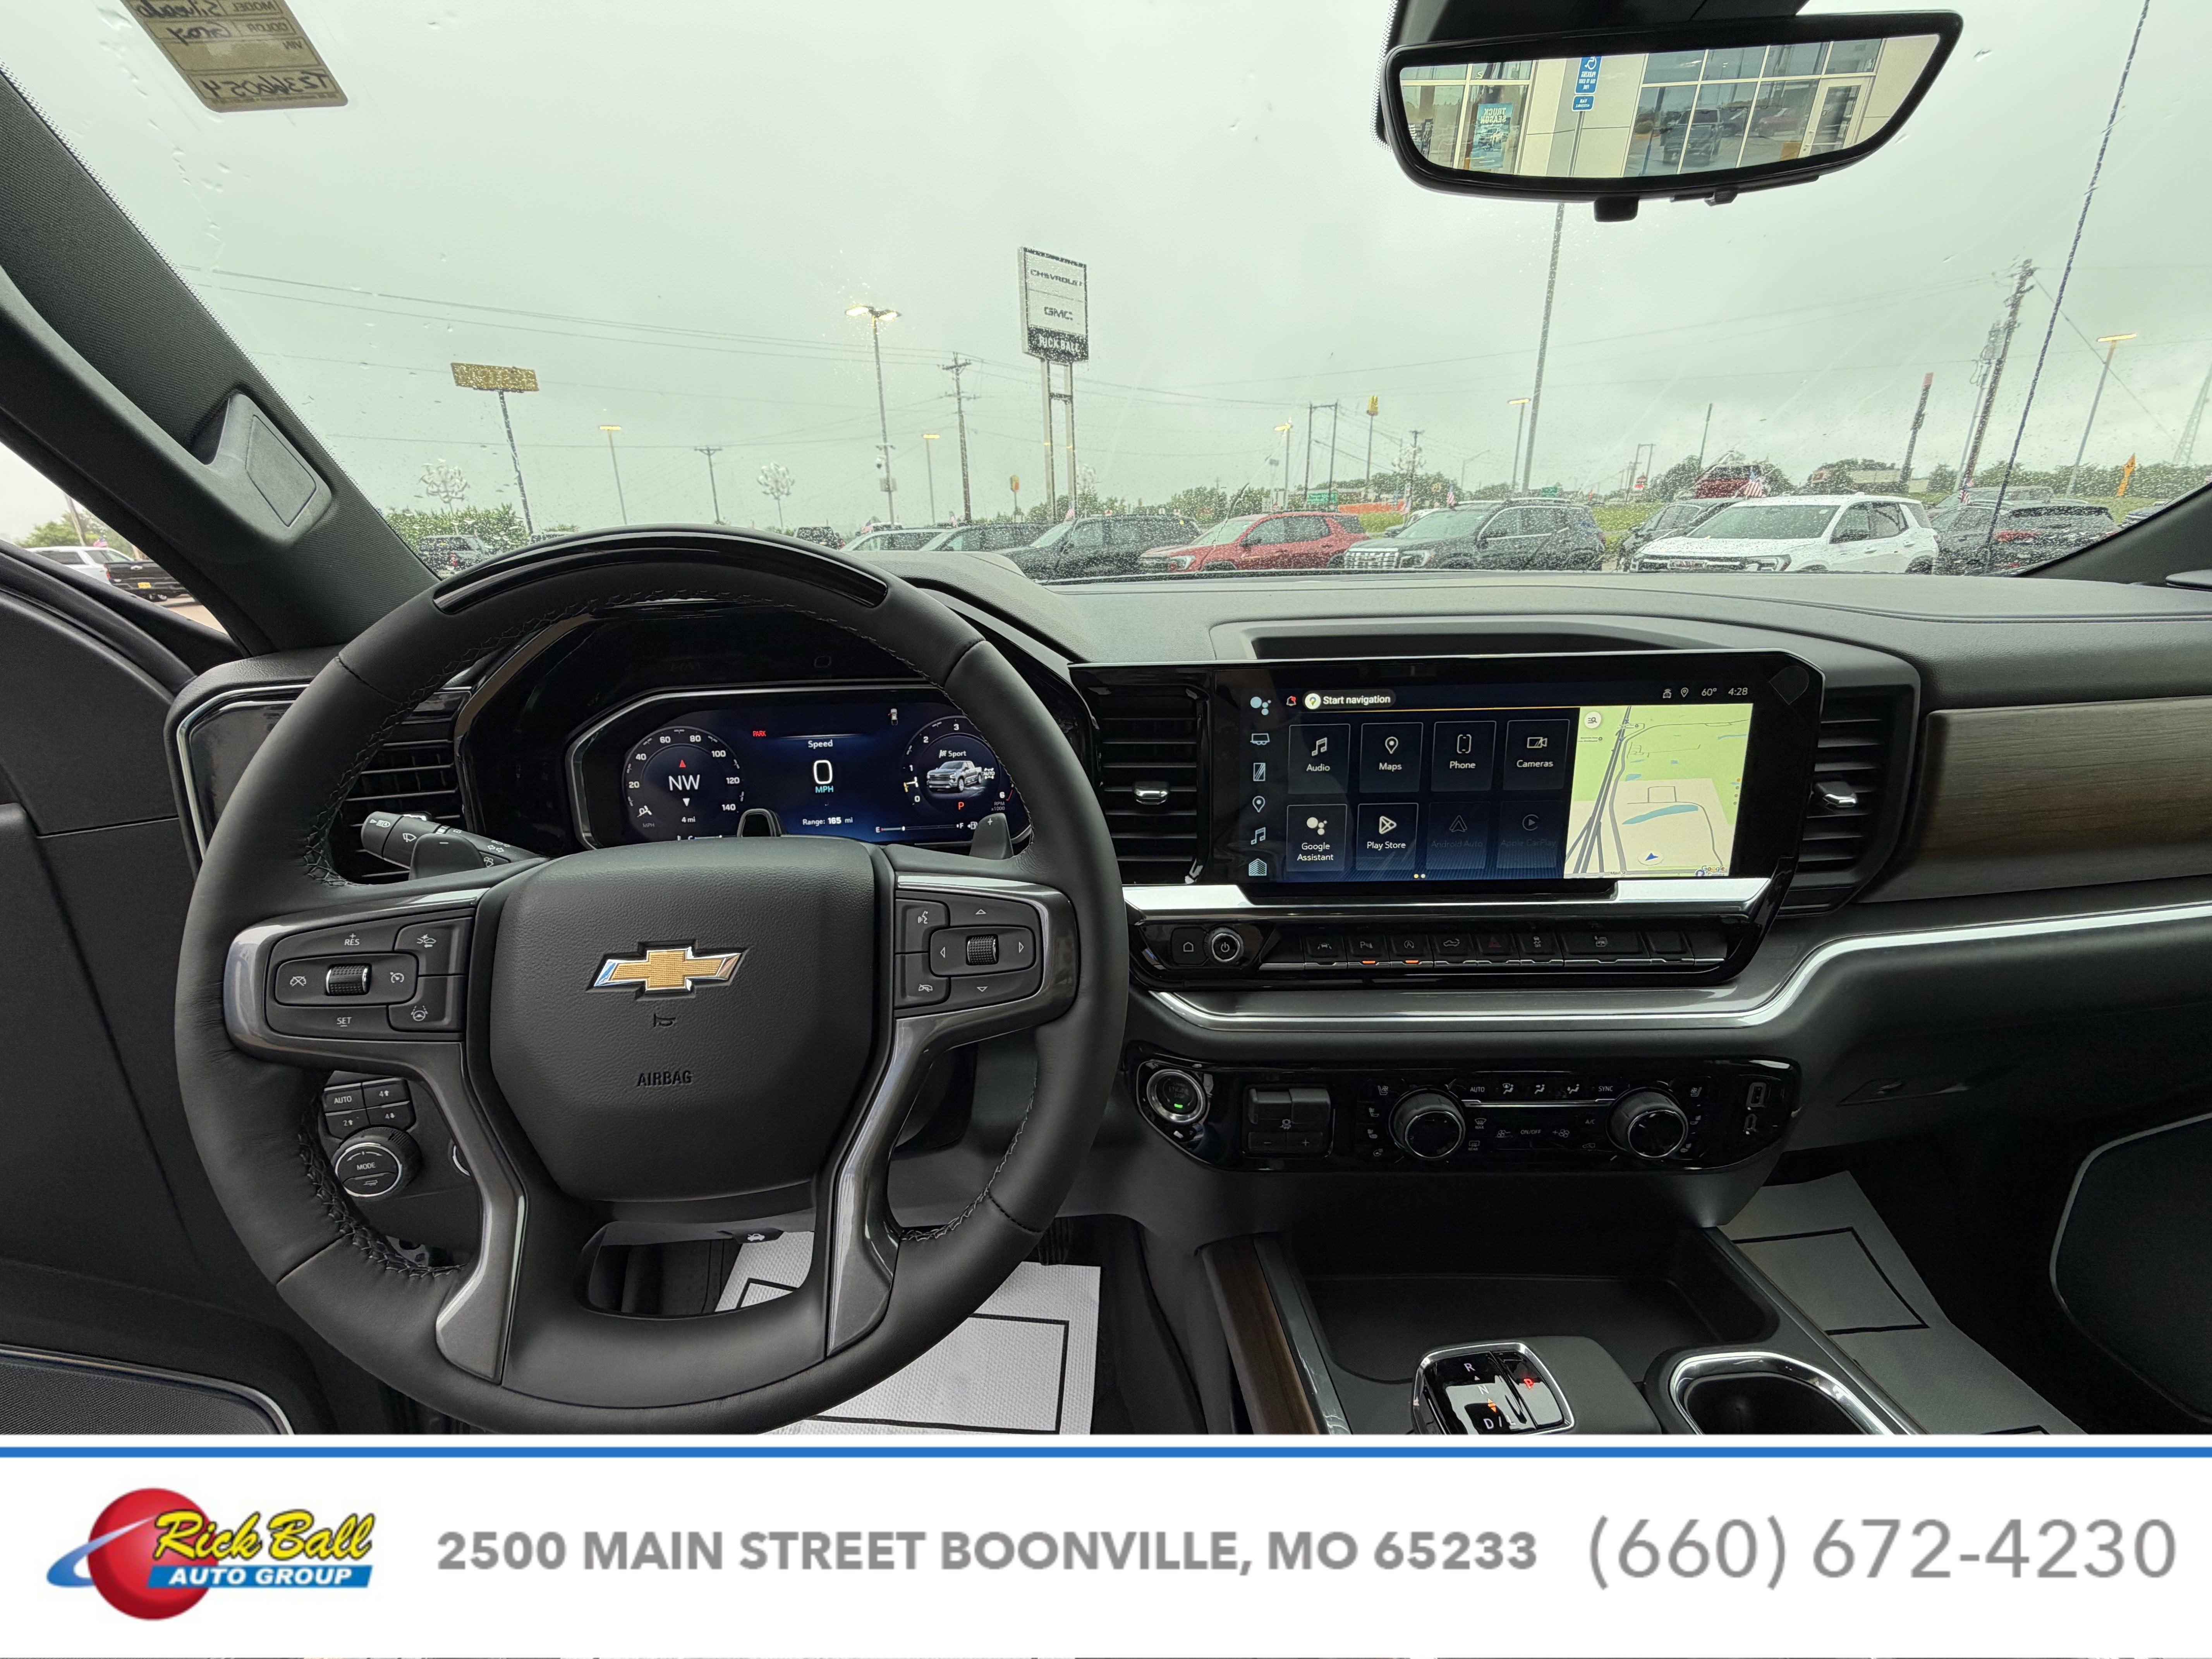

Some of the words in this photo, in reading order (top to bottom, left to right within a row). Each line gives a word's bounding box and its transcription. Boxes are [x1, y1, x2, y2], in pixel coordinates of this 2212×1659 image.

[1030, 269, 1083, 287] CHEVROLET
[1044, 306, 1073, 321] GMC
[1701, 687, 1717, 696] 60°
[1728, 687, 1748, 696] 4:28
[1323, 696, 1344, 705] Start
[1346, 695, 1391, 706] navigation
[808, 739, 833, 749] Speed
[1306, 763, 1330, 772] Audio
[1379, 762, 1402, 772] Maps
[1449, 761, 1476, 769] Phone
[814, 759, 833, 784] 0
[668, 774, 700, 791] NW
[802, 818, 825, 827] Range:
[1302, 842, 1330, 852] Google
[1367, 842, 1383, 851] Play
[1431, 840, 1462, 848] Android
[636, 1070, 693, 1087] AIRBAG
[334, 1095, 352, 1104] AUTO
[356, 1162, 376, 1170] MODE
[1463, 1363, 1476, 1372] R
[1523, 1377, 1534, 1389] P
[1477, 1385, 1489, 1395] N
